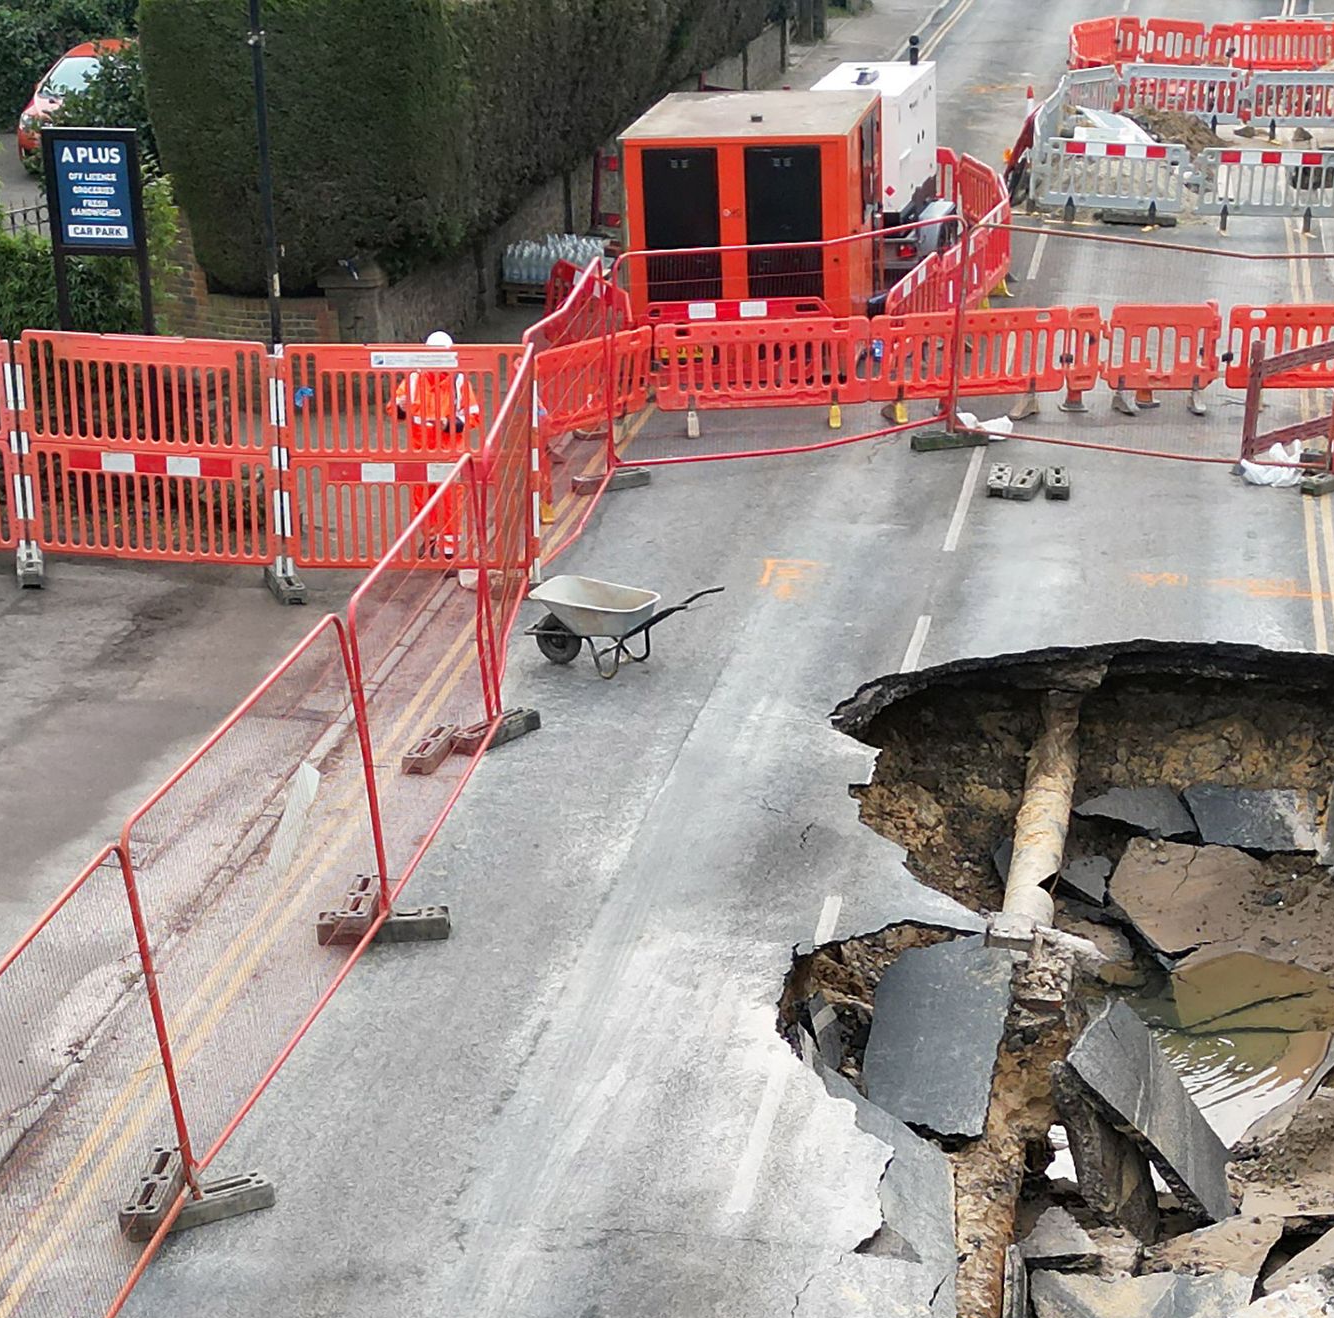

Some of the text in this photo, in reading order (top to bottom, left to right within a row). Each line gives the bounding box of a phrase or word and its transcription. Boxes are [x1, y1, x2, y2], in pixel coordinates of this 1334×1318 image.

[61, 146, 121, 164] A PLUS
[73, 227, 123, 237] CAR PARK
